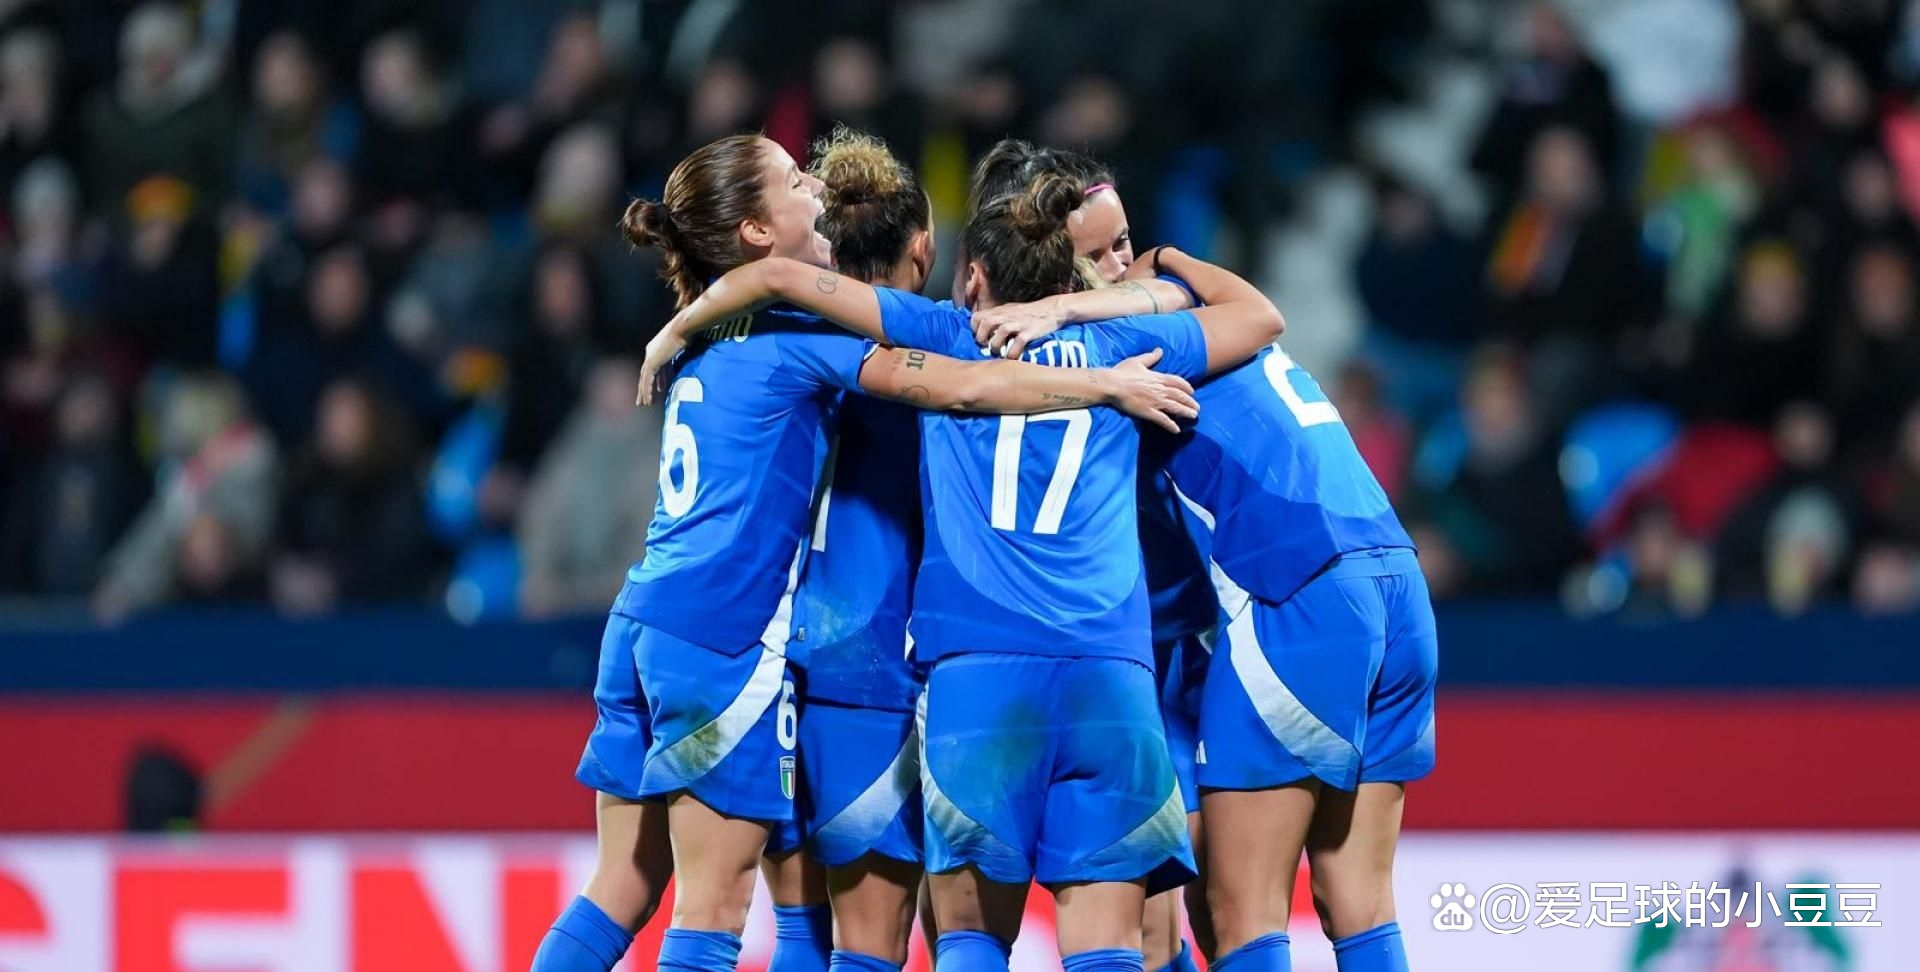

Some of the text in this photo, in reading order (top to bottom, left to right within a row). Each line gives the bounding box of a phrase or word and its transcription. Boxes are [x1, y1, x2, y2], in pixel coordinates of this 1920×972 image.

[906, 351, 926, 370] 10
[659, 376, 704, 518] 6
[990, 408, 1093, 535] 17
[777, 680, 798, 751] 6
